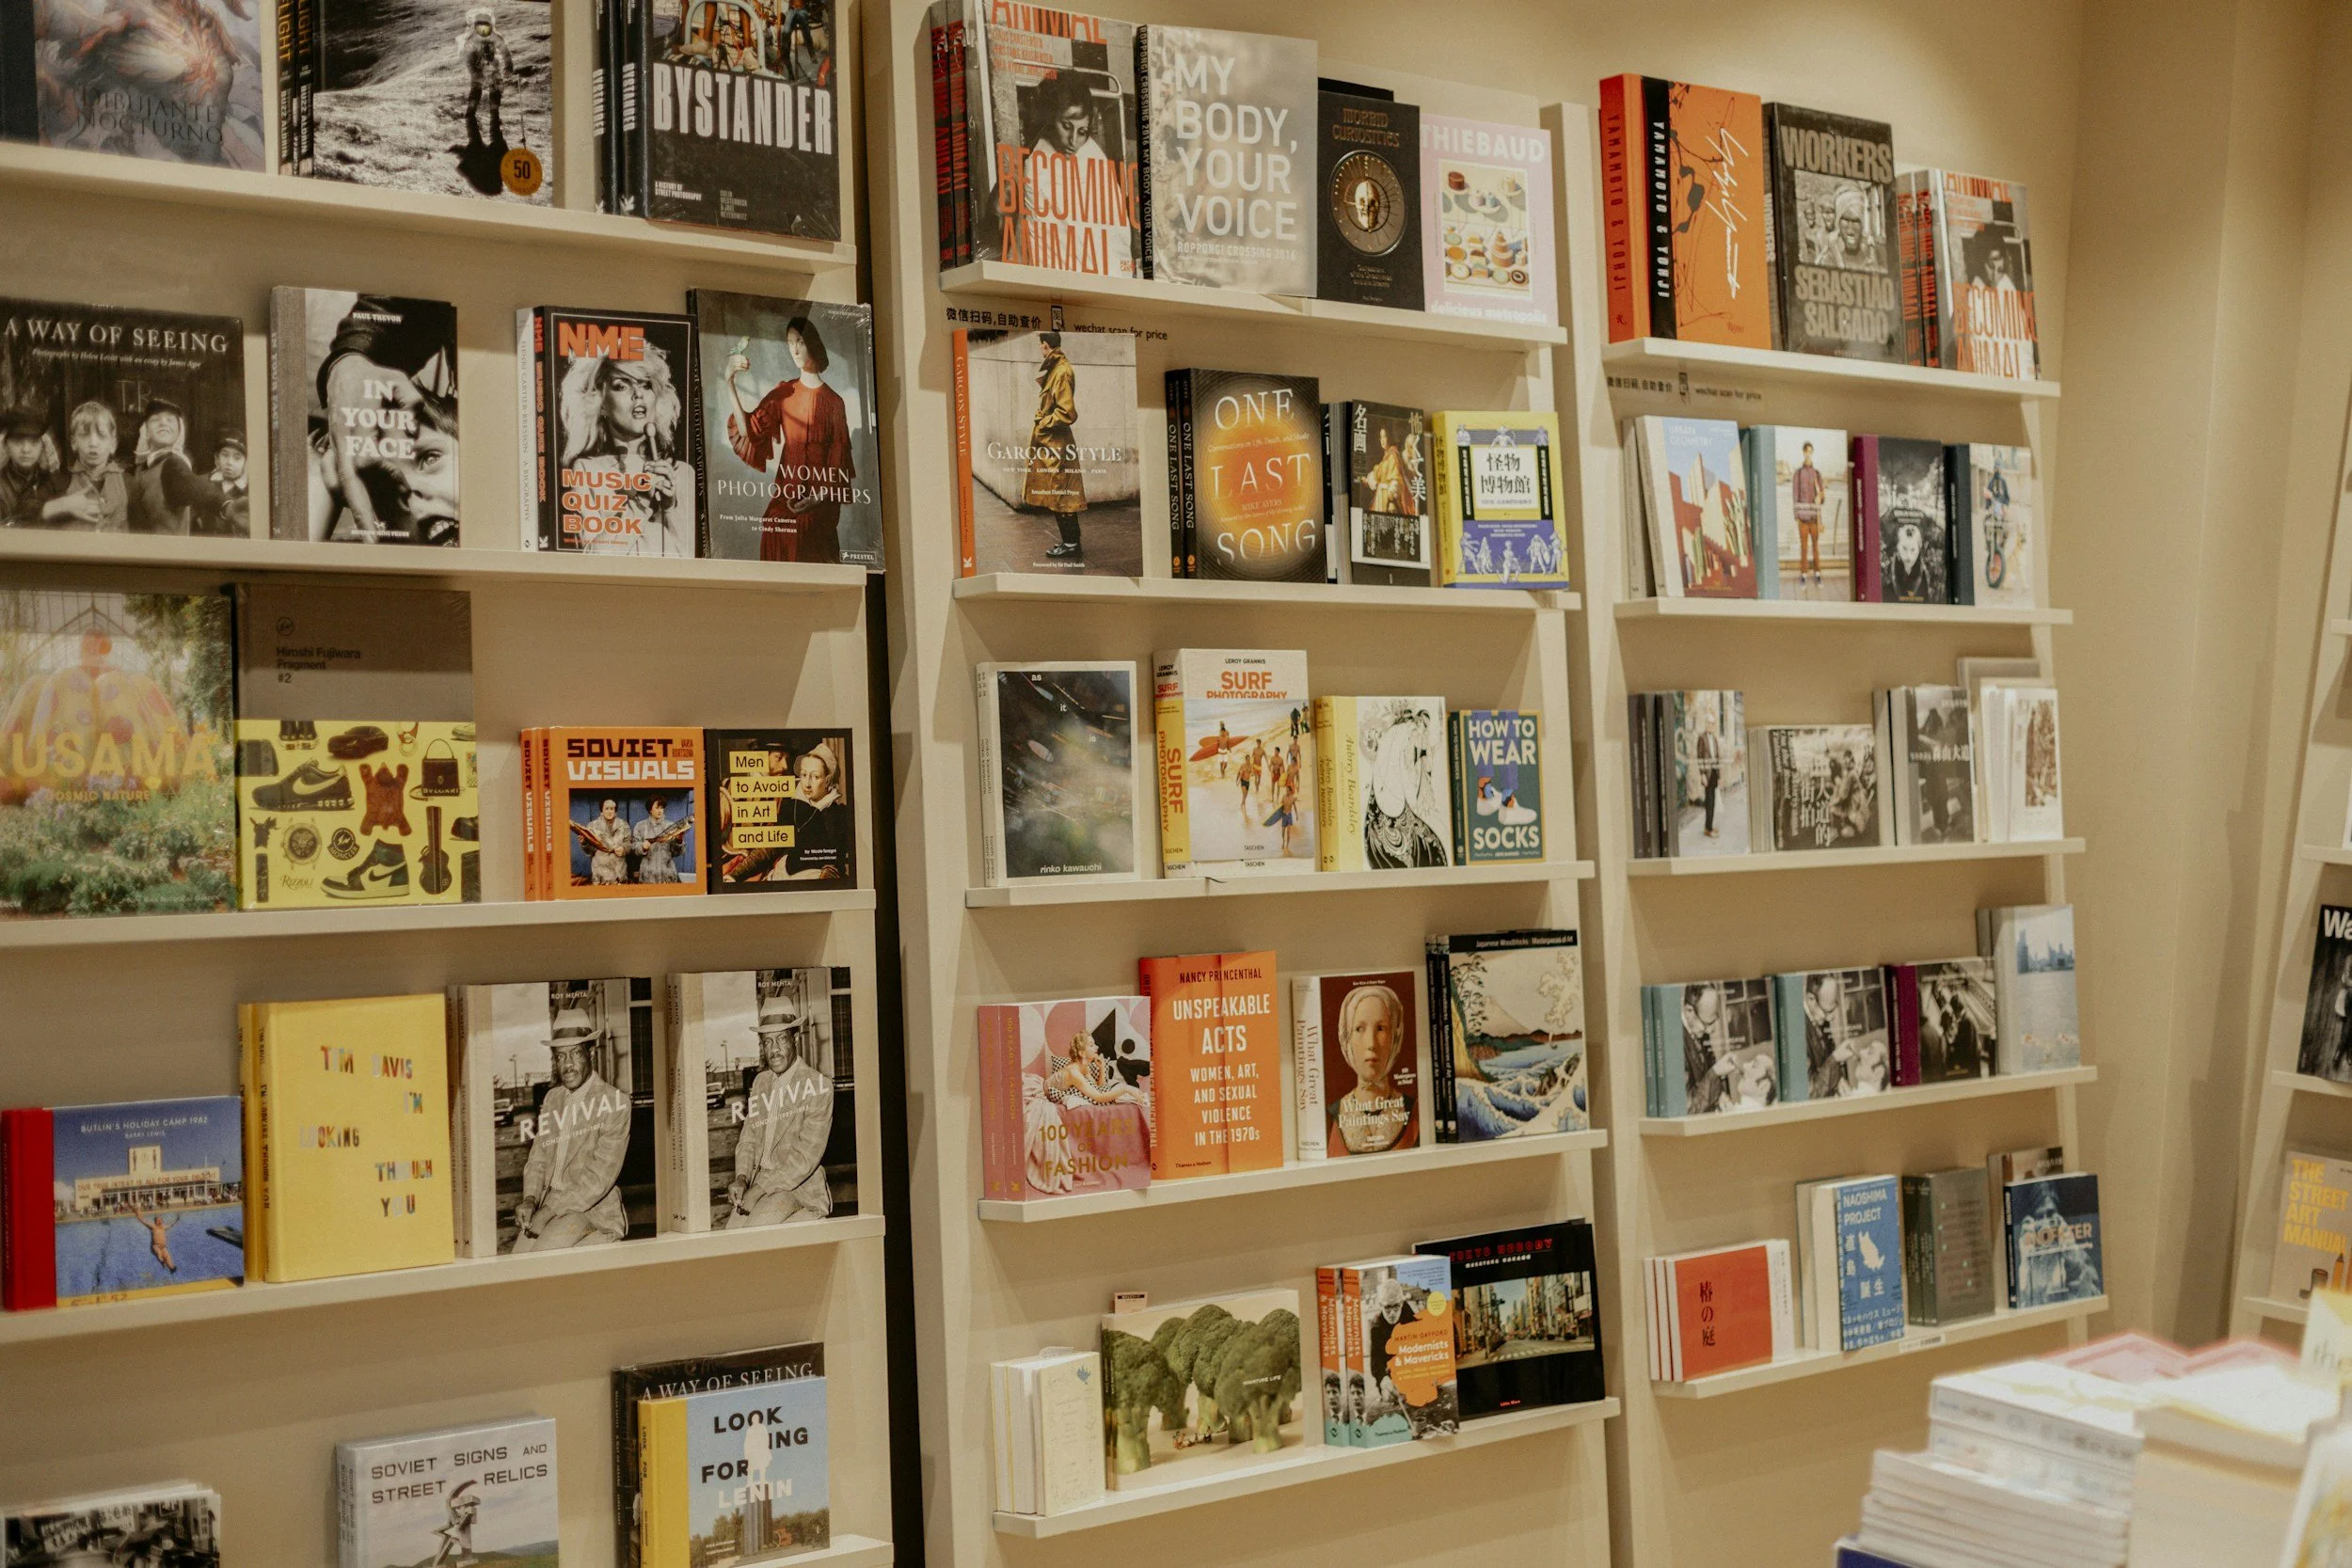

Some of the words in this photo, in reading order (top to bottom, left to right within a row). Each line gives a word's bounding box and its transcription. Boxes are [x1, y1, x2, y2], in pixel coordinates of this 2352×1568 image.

[992, 0, 1107, 44] ANIMAL
[1174, 55, 1235, 95] MY
[83, 87, 219, 122] DIBUJANTE
[654, 63, 832, 155] BYSTANDER
[78, 112, 223, 144] NOCTURNO
[1176, 100, 1297, 154] BODY,
[1343, 107, 1389, 127] MORBID
[1332, 124, 1400, 148] CURIOSITIES
[1420, 123, 1546, 163] THIEBAUD
[1607, 115, 1624, 207] YAMAMOTO
[1781, 125, 1894, 184] WORKERS
[514, 160, 531, 179] 50
[1176, 146, 1292, 195] YOUR
[1654, 121, 1667, 213] YAMAMOTO
[995, 143, 1139, 230] BECOMING
[1176, 194, 1297, 242] VOICE
[1656, 225, 1668, 234] &
[1000, 215, 1108, 276] ANIMAL
[1613, 239, 1626, 291] YOHJI
[1657, 245, 1670, 298] YOHJI
[373, 314, 402, 323] TREVOR
[1431, 301, 1483, 320] delicious
[1074, 323, 1105, 333] wechat
[1130, 326, 1144, 338] for
[1146, 331, 1168, 341] price
[1804, 301, 1889, 344] SALGADO
[5, 318, 19, 337] A
[27, 319, 82, 341] WAY
[89, 325, 122, 344] OF
[133, 328, 229, 354] SEEING
[559, 322, 644, 361] NME
[362, 379, 396, 401] IN
[340, 406, 418, 431] YOUR
[1215, 388, 1294, 430] ONE
[1353, 404, 1368, 453] 名画
[344, 436, 416, 459] FACE
[1670, 436, 1713, 447] GEOMETRY
[988, 442, 1061, 466] GARÇON
[1066, 444, 1121, 462] STYLE
[1486, 452, 1520, 473] 怪物
[562, 468, 653, 492] MUSIC
[780, 464, 850, 483] WOMEN
[1211, 452, 1311, 499] LAST
[1480, 475, 1531, 494] 博物館
[562, 492, 628, 513] QUIZ
[718, 480, 871, 505] PHOTOGRAPHERS
[1242, 501, 1261, 512] MIKE
[1262, 499, 1282, 508] AYERS
[563, 514, 644, 535] BOOK
[1216, 519, 1315, 564] SONG
[277, 647, 315, 657] Hiroshi
[317, 647, 361, 659] Fujiwara
[278, 660, 326, 671] Fragment
[278, 673, 292, 683] #2
[1157, 682, 1179, 692] SURF
[1221, 672, 1272, 689] SURF
[1469, 720, 1509, 738] HOW
[1515, 719, 1535, 738] TO
[0, 733, 217, 778] USAMA
[567, 738, 673, 758] SOVIET
[1470, 740, 1536, 767] WEAR
[567, 760, 694, 781] VISUALS
[736, 756, 764, 768] Men
[103, 790, 151, 800] NATURE
[737, 782, 748, 792] to
[753, 781, 789, 792] Avoid
[738, 806, 748, 817] in
[753, 806, 771, 817] Art
[739, 832, 763, 842] and
[768, 831, 788, 842] Life
[1472, 826, 1540, 850] SOCKS
[1040, 865, 1060, 874] rinko
[1062, 863, 1102, 873] kawauchi
[1500, 939, 1528, 947] Woodblocks
[1532, 937, 1561, 945] Masterpieces
[1180, 972, 1207, 984] NANCY
[1209, 968, 1262, 982] PRINCENTHAL
[1173, 993, 1270, 1021] UNSPEAKABLE
[1201, 1025, 1247, 1054] ACTS
[321, 1045, 354, 1074] TIM
[372, 1054, 413, 1080] DAVIS
[1190, 1065, 1234, 1083] WOMEN,
[1237, 1062, 1260, 1079] ART,
[404, 1091, 422, 1114] I'M
[731, 1073, 830, 1124] REVIVAL
[1194, 1088, 1216, 1104] AND
[1219, 1085, 1257, 1101] SEXUAL
[1343, 1099, 1373, 1113] What
[1375, 1097, 1405, 1109] Great
[81, 1124, 120, 1133] BUTLIN'S
[123, 1119, 160, 1130] HOLIDAY
[163, 1117, 186, 1126] CAMP
[189, 1116, 208, 1124] 1982
[519, 1088, 627, 1143] REVIVAL
[1201, 1106, 1251, 1124] VIOLENCE
[1338, 1112, 1388, 1129] Paintings
[1391, 1110, 1410, 1125] Say
[299, 1125, 359, 1148] LOOKING
[1039, 1125, 1068, 1142] 100
[1071, 1117, 1135, 1138] YEARS
[1195, 1131, 1205, 1147] IN
[1209, 1129, 1228, 1145] THE
[1231, 1127, 1260, 1142] 1970s
[1077, 1142, 1091, 1152] OF
[375, 1160, 432, 1182] THROUGH
[1045, 1154, 1128, 1176] FASHION
[2292, 1159, 2325, 1183] THE
[111, 1180, 134, 1188] INTENT
[381, 1195, 415, 1217] YOU
[1843, 1188, 1887, 1207] NAOSHIMA
[2289, 1180, 2348, 1212] STREET
[1844, 1207, 1882, 1226] PROJECT
[2286, 1203, 2322, 1225] ART
[1449, 1246, 1490, 1262] TOKYO
[1498, 1239, 1553, 1255] NOBODY
[2283, 1224, 2346, 1254] MANUAL
[1699, 1280, 1716, 1348] 椿の庭
[1395, 1333, 1418, 1341] MARTIN
[1420, 1330, 1448, 1338] GAYFORD
[1399, 1340, 1448, 1354] Modernists
[1404, 1352, 1449, 1365] Mavericks
[643, 1387, 652, 1401] A
[659, 1379, 701, 1399] WAY
[706, 1375, 733, 1392] OF
[740, 1363, 813, 1386] SEEING
[714, 1406, 784, 1433] LOOK
[769, 1427, 808, 1449] ING
[372, 1458, 437, 1480] SOVIET
[454, 1447, 507, 1465] SIGNS
[523, 1444, 547, 1456] AND
[702, 1459, 749, 1483] FOR
[372, 1481, 446, 1504] STREET
[484, 1465, 548, 1485] RELICS
[719, 1479, 792, 1509] LENIN
